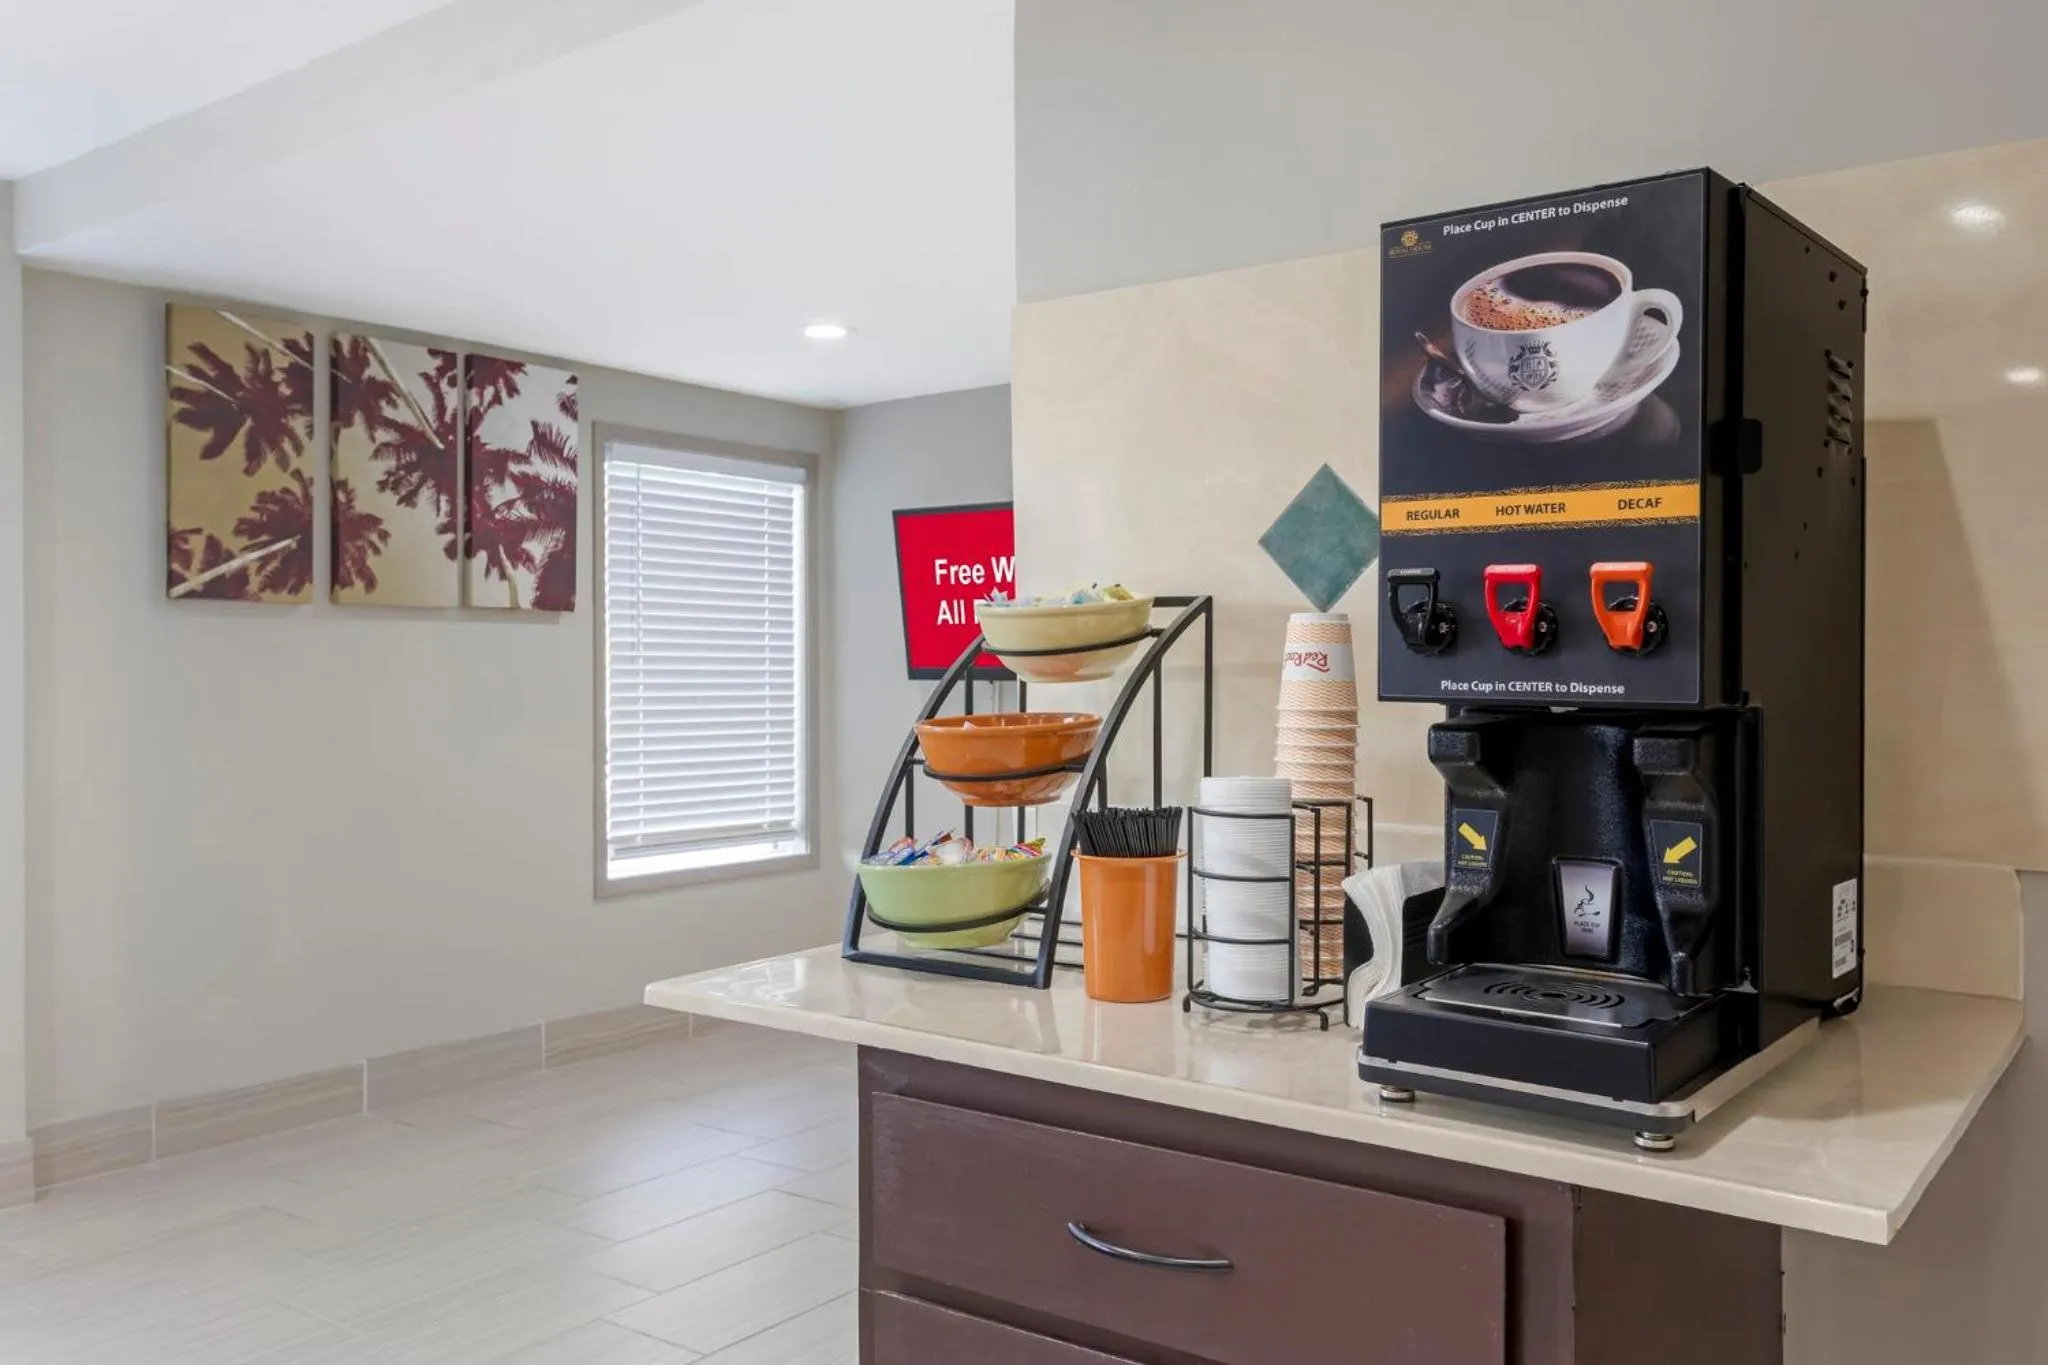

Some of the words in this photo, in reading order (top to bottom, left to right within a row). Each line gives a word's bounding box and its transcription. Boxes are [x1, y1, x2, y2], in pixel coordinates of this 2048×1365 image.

[1443, 223, 1472, 236] Place
[1473, 219, 1496, 231] Cup
[1498, 216, 1509, 227] in
[1511, 206, 1556, 224] CENTER
[1558, 206, 1571, 216] to
[1573, 197, 1629, 213] Dispense
[1495, 505, 1521, 516] HOT
[1523, 502, 1566, 515] WATER
[1617, 497, 1663, 510] DECAF
[1406, 508, 1460, 521] REGULAR
[934, 558, 986, 585] Free
[937, 599, 966, 625] All
[1441, 680, 1469, 691] Place
[1471, 680, 1493, 694] Cup
[1495, 680, 1506, 691] in
[1508, 681, 1553, 692] CENTER
[1555, 682, 1568, 692] to
[1569, 682, 1625, 695] Dispense
